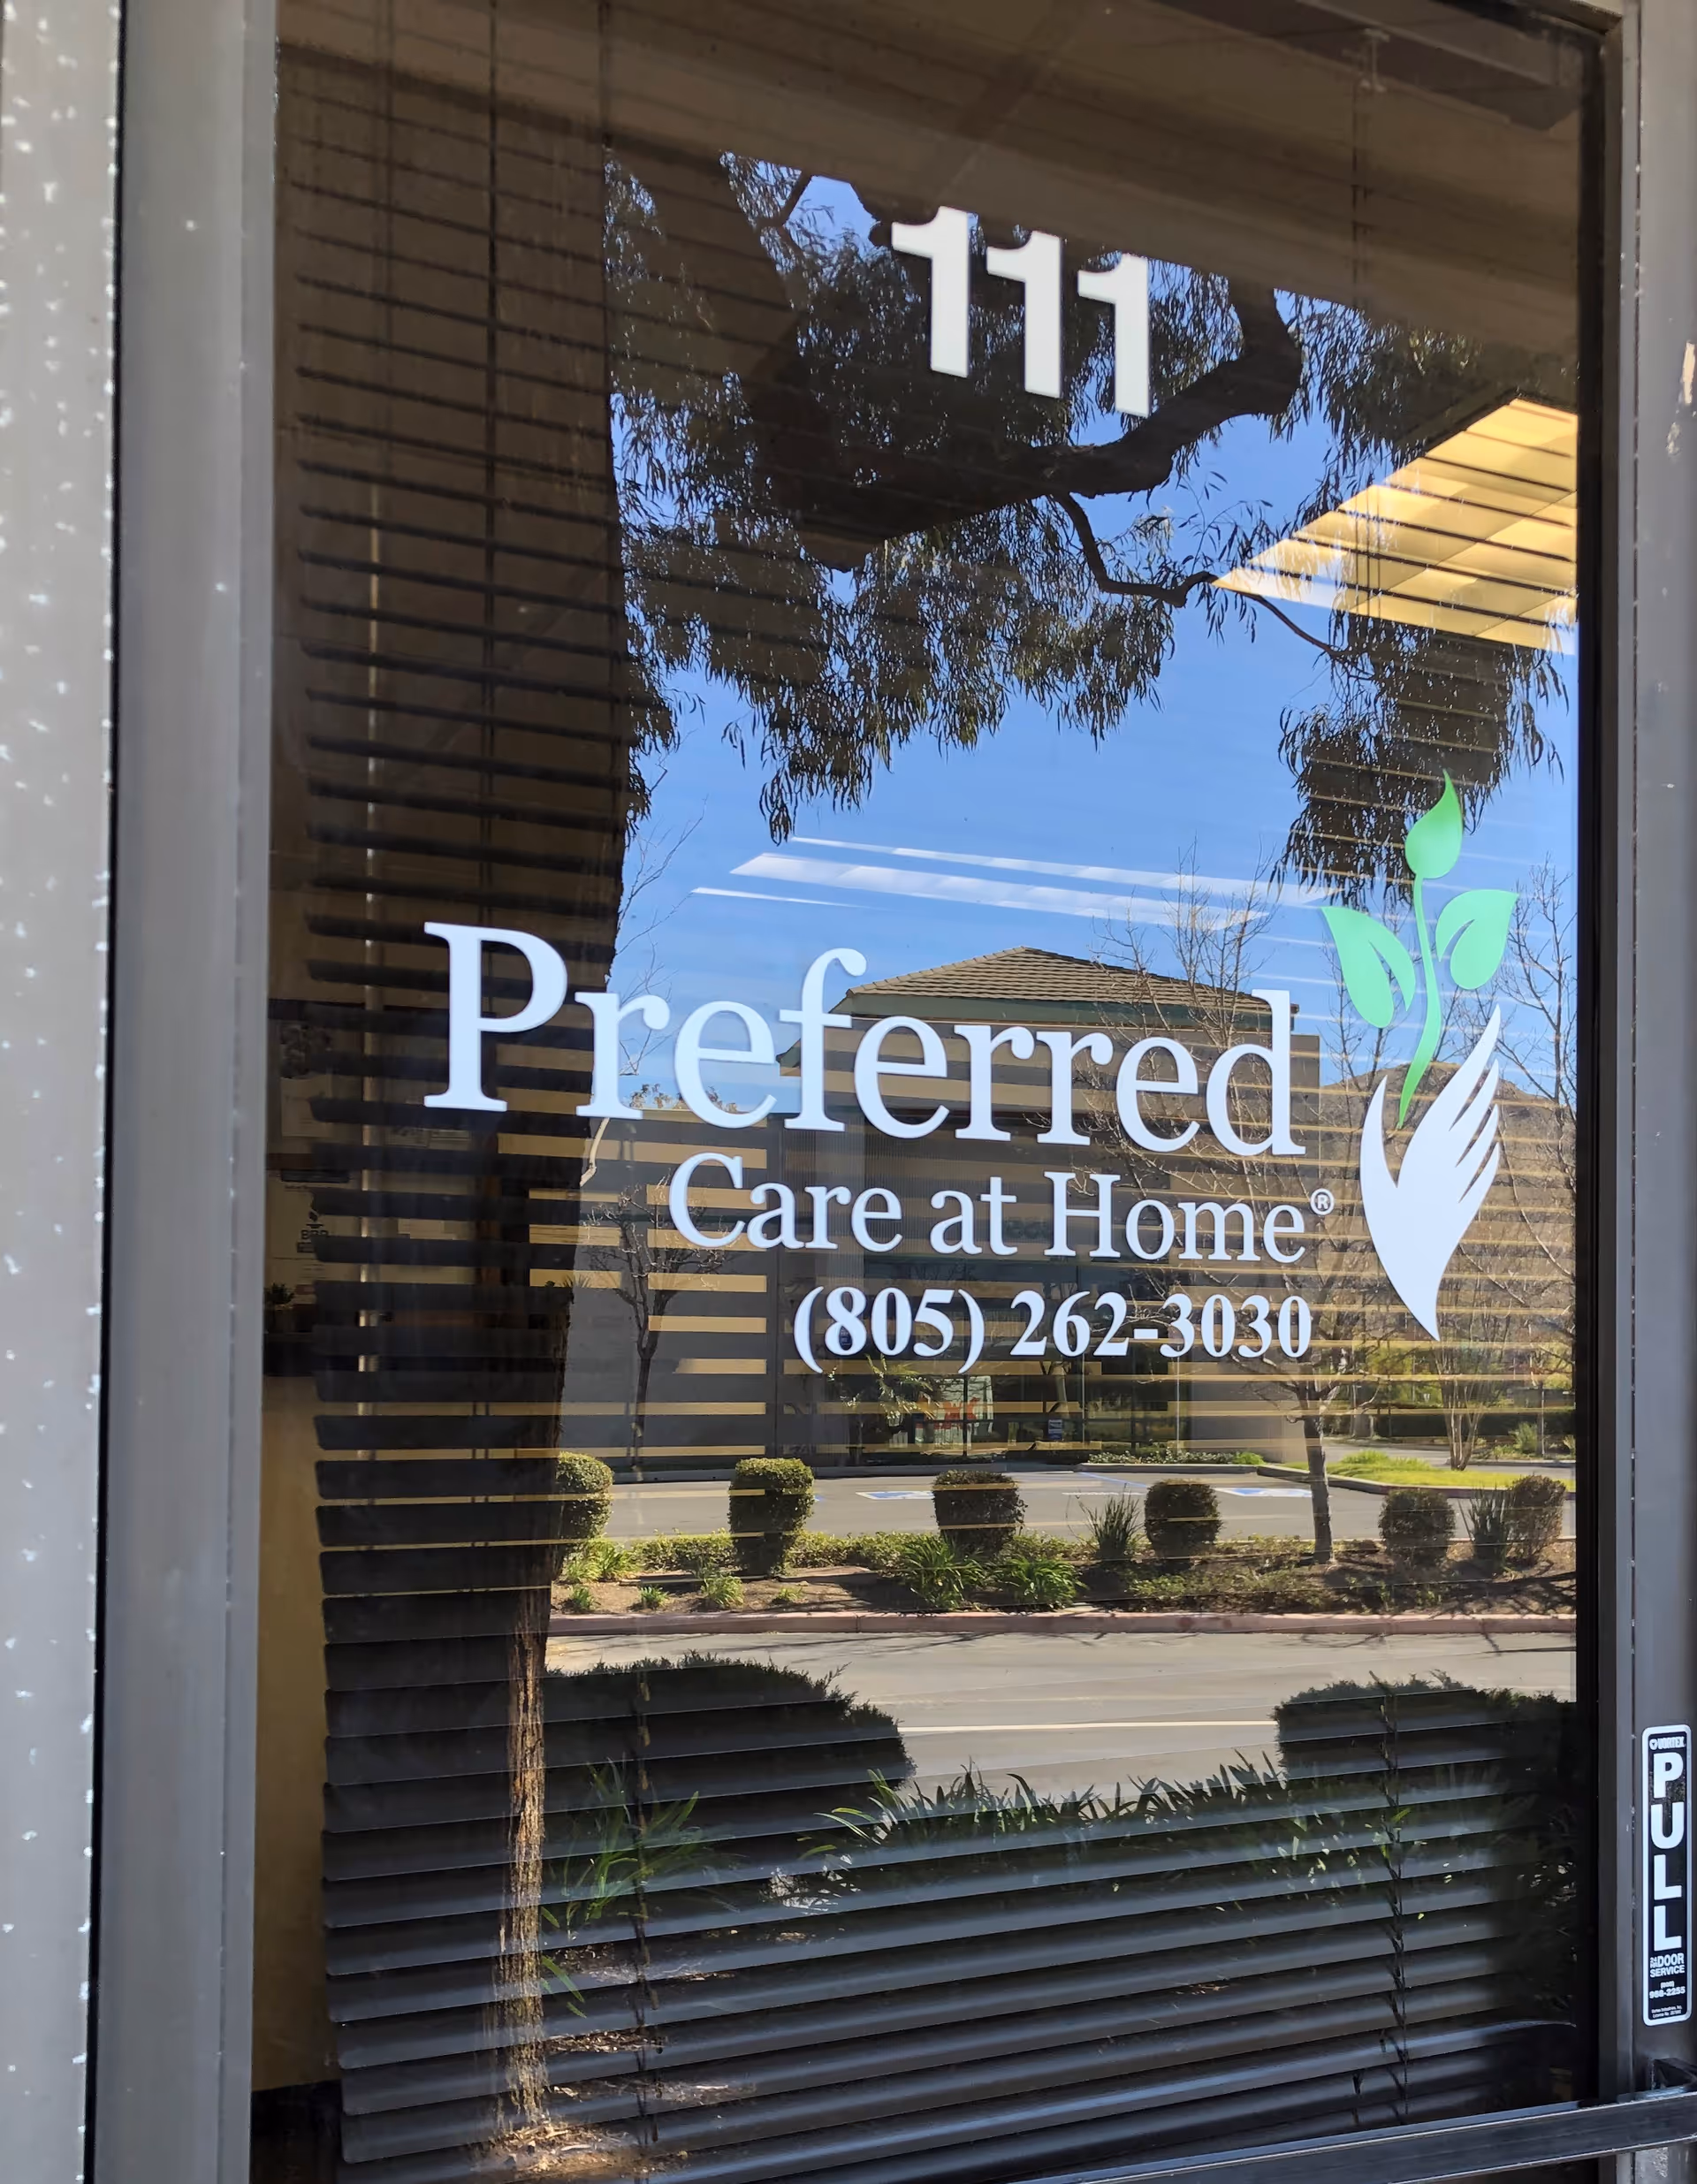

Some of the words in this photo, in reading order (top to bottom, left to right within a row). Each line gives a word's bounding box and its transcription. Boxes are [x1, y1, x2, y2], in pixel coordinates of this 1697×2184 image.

[891, 205, 1150, 419] 111
[423, 921, 1306, 1156] Preferred
[668, 1152, 903, 1252] Care
[930, 1176, 1018, 1256] at
[793, 1286, 985, 1374] (805)
[1009, 1290, 1313, 1358] 262-3030
[1651, 1752, 1685, 1952] PULL
[1649, 1964, 1686, 1978] SERVICE
[1657, 1952, 1685, 1968] DOOR
